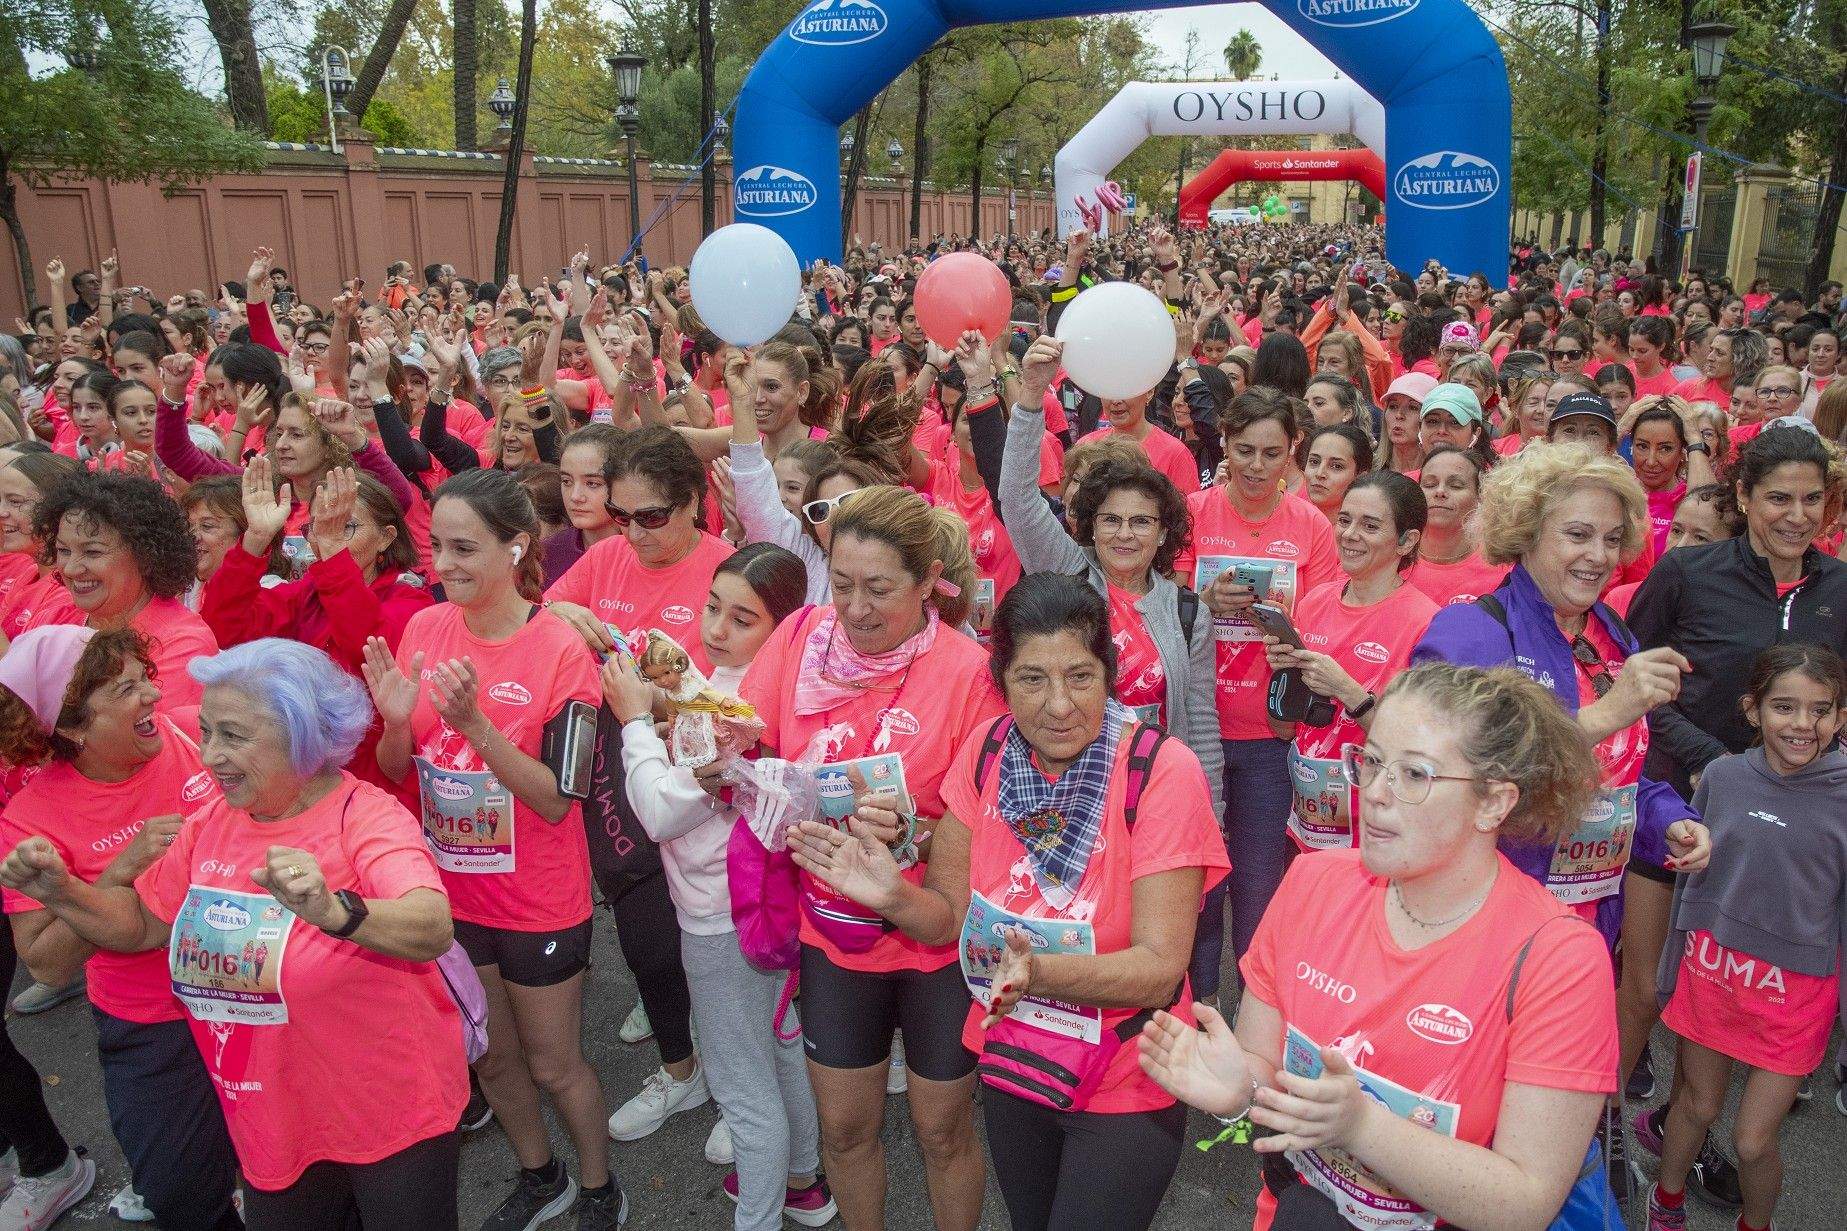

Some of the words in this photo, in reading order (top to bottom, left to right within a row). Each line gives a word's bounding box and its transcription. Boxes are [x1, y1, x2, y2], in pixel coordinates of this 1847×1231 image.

[794, 17, 879, 35] ASTURIANA
[1173, 90, 1325, 121] OYSHO
[1254, 160, 1281, 171] Sports
[1294, 159, 1339, 169] Santander
[1455, 169, 1491, 177] LECHERA
[1400, 174, 1493, 195] ASTURIANA
[737, 186, 810, 204] ASTURIANA
[1201, 536, 1236, 548] OYSHO
[1215, 628, 1234, 636] SHO
[1517, 655, 1535, 666] RICH
[821, 783, 854, 793] STURIAN
[436, 812, 473, 833] 016
[91, 820, 145, 852] OYSHO
[1569, 840, 1608, 860] 016
[206, 912, 247, 926] ASTURIANA
[199, 950, 238, 977] 016
[1685, 930, 1786, 994] SUMA
[209, 978, 224, 989] 186
[1296, 961, 1357, 1004] OYSHO
[203, 988, 209, 996] DE
[210, 989, 218, 997] LA
[240, 993, 264, 1002] SEVILLA
[236, 1007, 273, 1018] Santander
[1055, 1001, 1081, 1012] SEVILLA
[1045, 1014, 1085, 1030] Santander
[240, 1081, 263, 1092] MUJER
[1295, 1154, 1331, 1194] OYSHO
[1331, 1159, 1358, 1183] 6964
[1341, 1181, 1368, 1201] MUJER
[1374, 1198, 1410, 1210] SEVILLA
[1357, 1211, 1414, 1226] Santander
